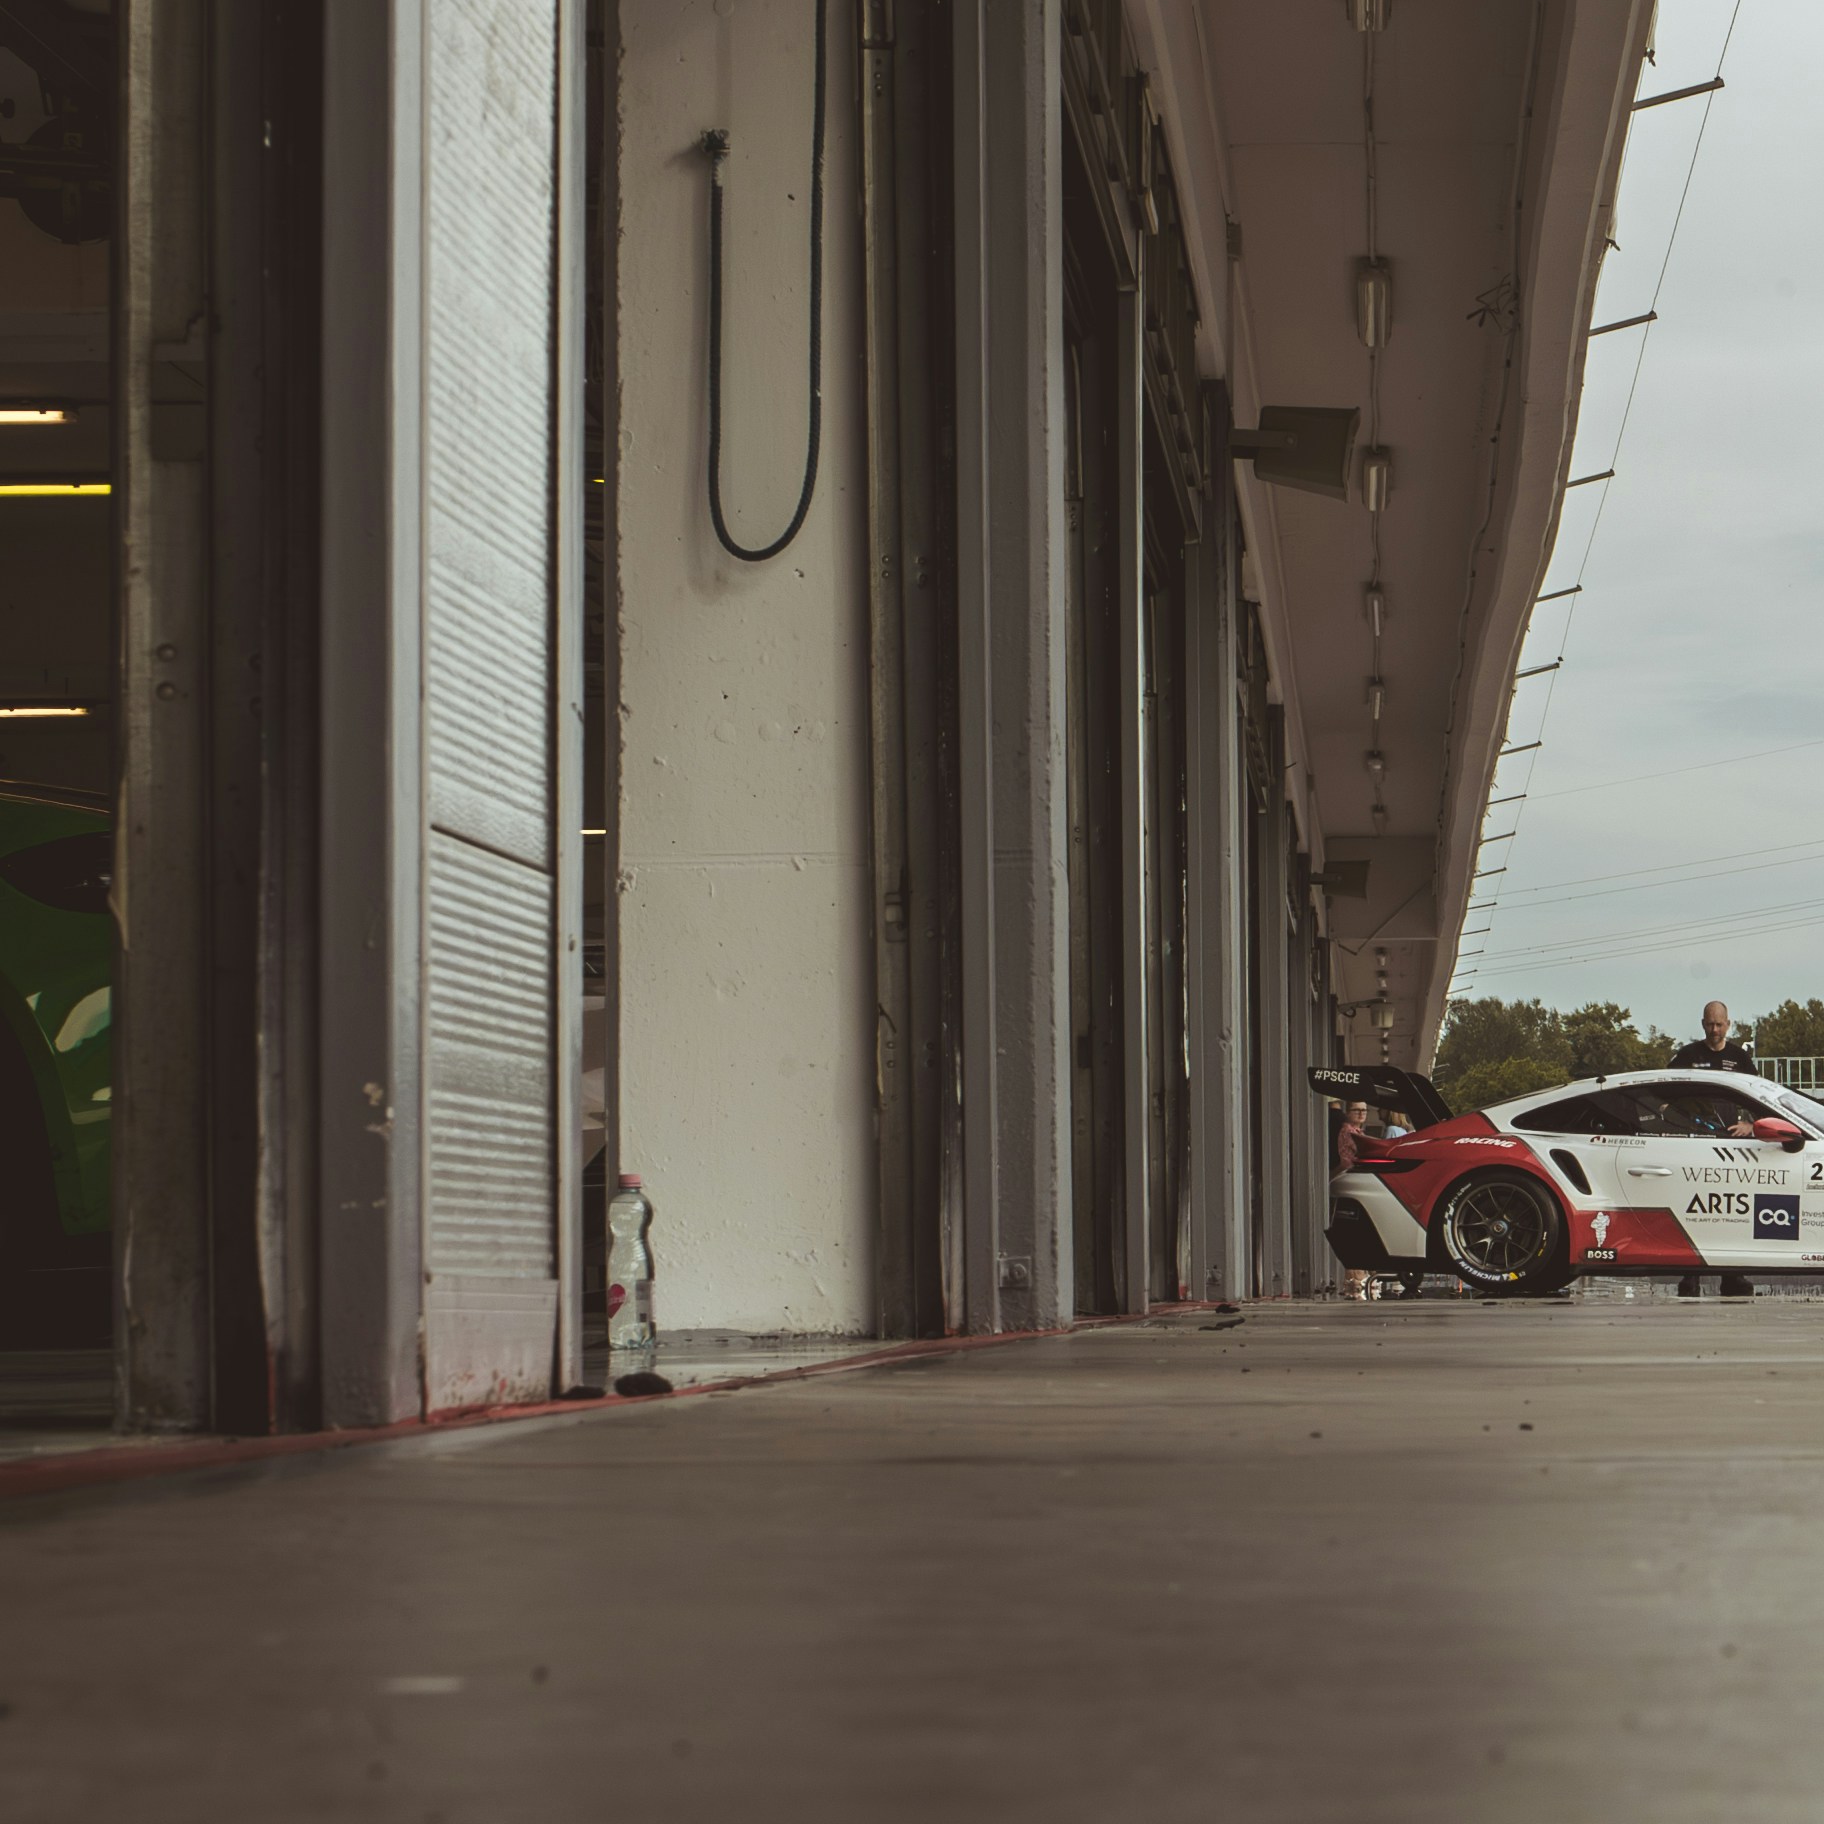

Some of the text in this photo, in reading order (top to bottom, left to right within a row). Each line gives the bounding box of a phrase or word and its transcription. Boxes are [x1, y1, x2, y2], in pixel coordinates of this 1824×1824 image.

[1314, 1070, 1361, 1085] #PSCCE
[1454, 1137, 1517, 1148] RACING
[1607, 1137, 1647, 1146] HENECON
[1681, 1166, 1791, 1185] WESTWERT
[1685, 1192, 1750, 1214] ARTS
[1758, 1208, 1791, 1226] CQ
[1587, 1250, 1615, 1260] BOSS
[1458, 1260, 1501, 1281] MICHELIN
